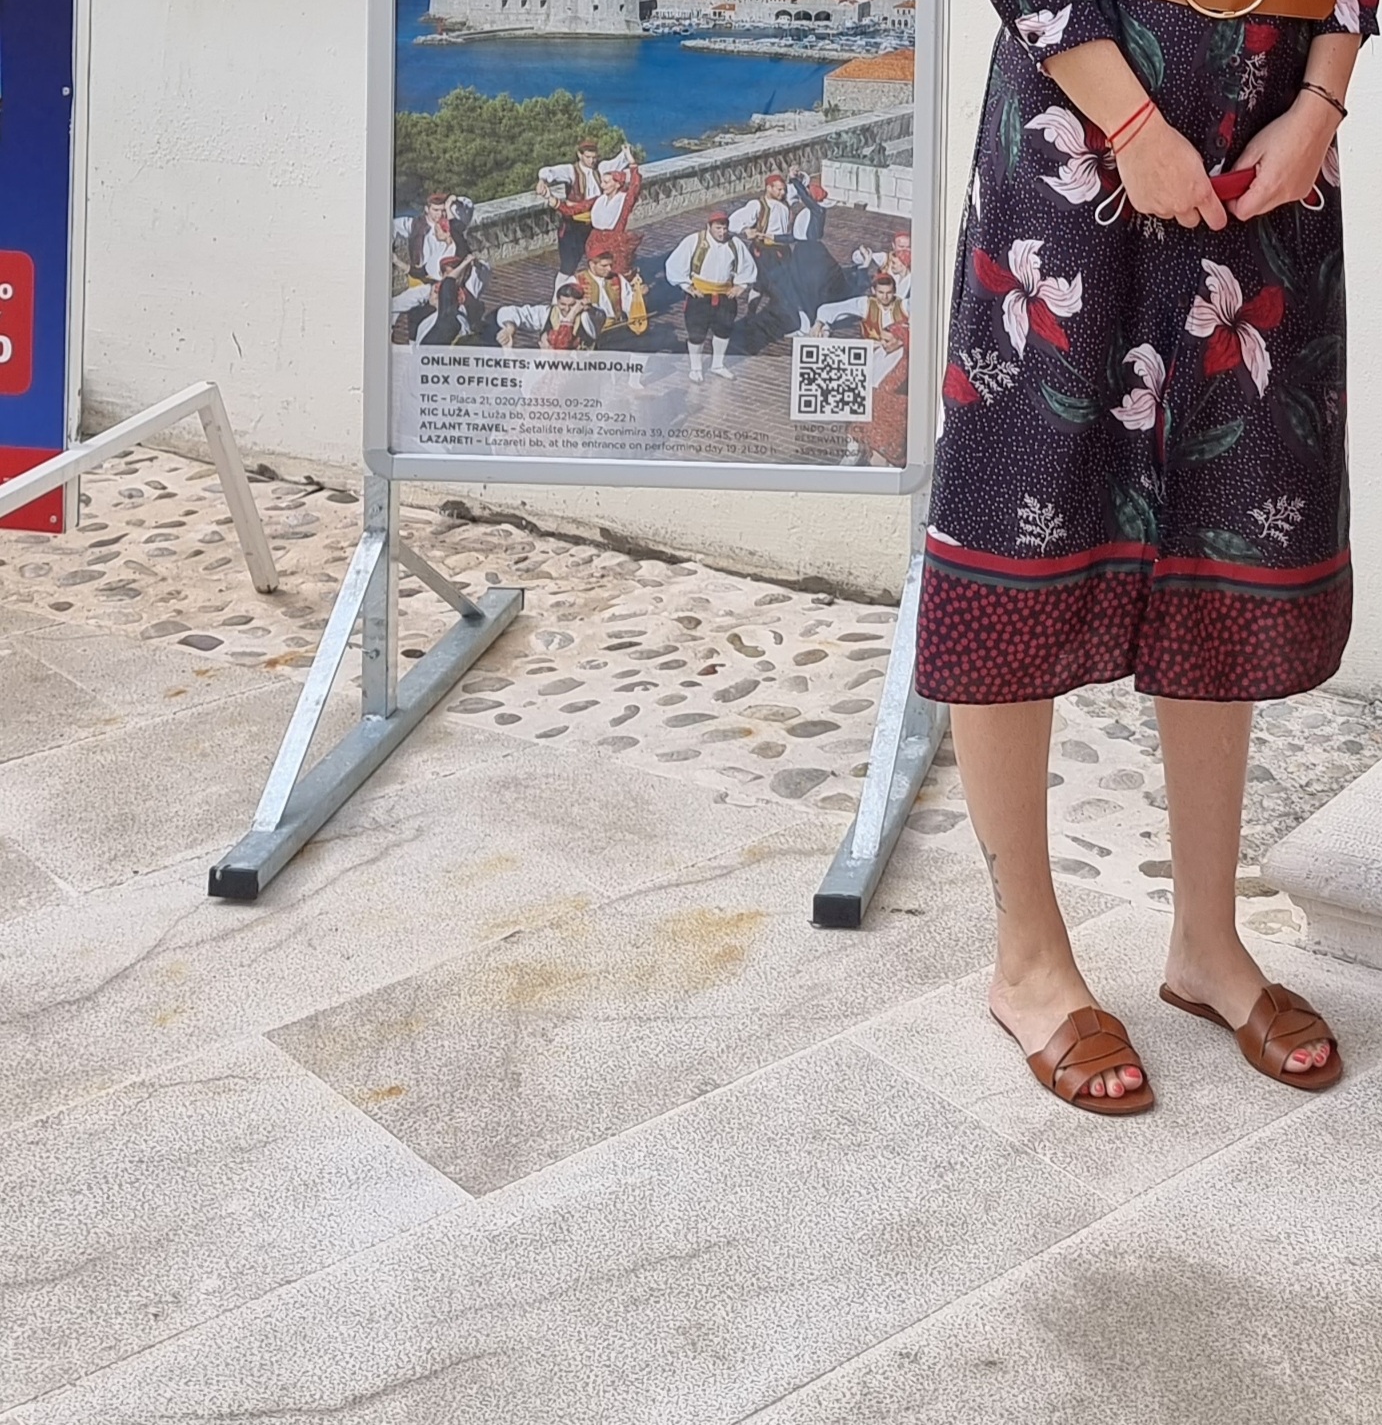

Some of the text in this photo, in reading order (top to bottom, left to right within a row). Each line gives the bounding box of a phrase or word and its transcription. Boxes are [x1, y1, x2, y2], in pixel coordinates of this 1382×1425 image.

[420, 356, 644, 374] ONLINE TICKETS: WWW.LINDJO.HR
[420, 374, 523, 388] BOX OFFICES:
[420, 393, 438, 403] TIC
[479, 395, 492, 406] 21,
[494, 396, 562, 409] 020/323350,
[564, 398, 603, 409] 09-22h
[420, 407, 439, 417] KIC
[442, 406, 471, 419] LUŽA
[481, 409, 506, 420] Luža
[509, 409, 525, 422] bb,
[528, 410, 592, 423] 020/321425,
[596, 412, 627, 423] 09-22
[629, 413, 636, 423] h
[420, 421, 464, 432] ATLANT
[466, 422, 508, 433] TRAVEL
[566, 424, 594, 437] kralja
[596, 425, 647, 437] Zvonimira
[650, 428, 665, 439] 39,
[419, 435, 473, 446] LAZARETI
[485, 436, 526, 447] Lazareti
[529, 437, 546, 449] bb,
[549, 439, 560, 448] at
[562, 438, 579, 449] the
[582, 440, 626, 451] entrance
[629, 441, 643, 451] on
[644, 440, 702, 454] performing
[705, 443, 723, 455] day
